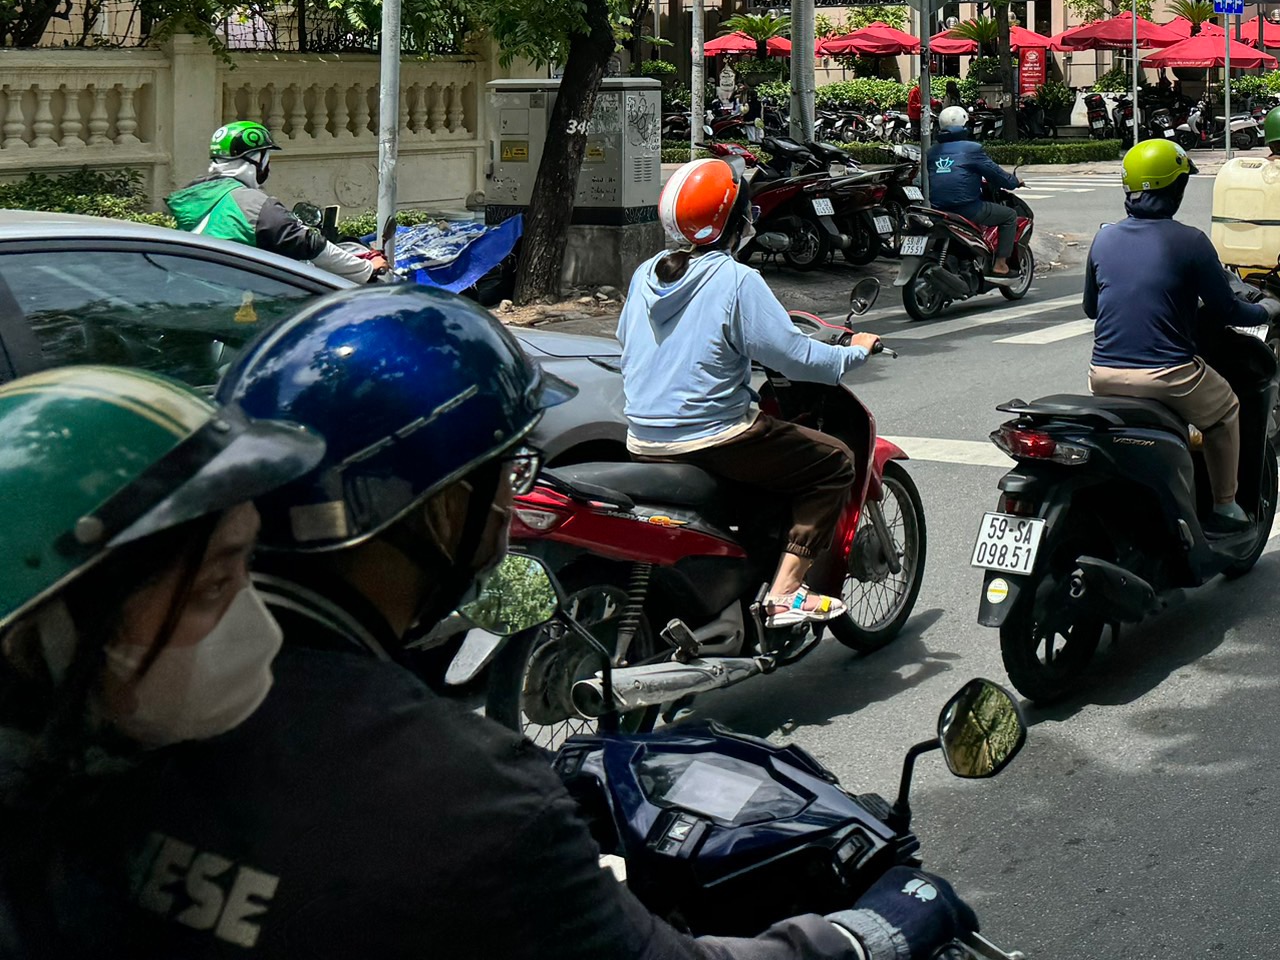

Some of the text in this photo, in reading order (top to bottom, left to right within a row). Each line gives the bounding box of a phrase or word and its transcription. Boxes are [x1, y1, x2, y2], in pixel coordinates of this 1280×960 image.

[988, 517, 1034, 545] 59-SA
[976, 541, 1032, 571] 098.51
[130, 832, 280, 948] ESE
